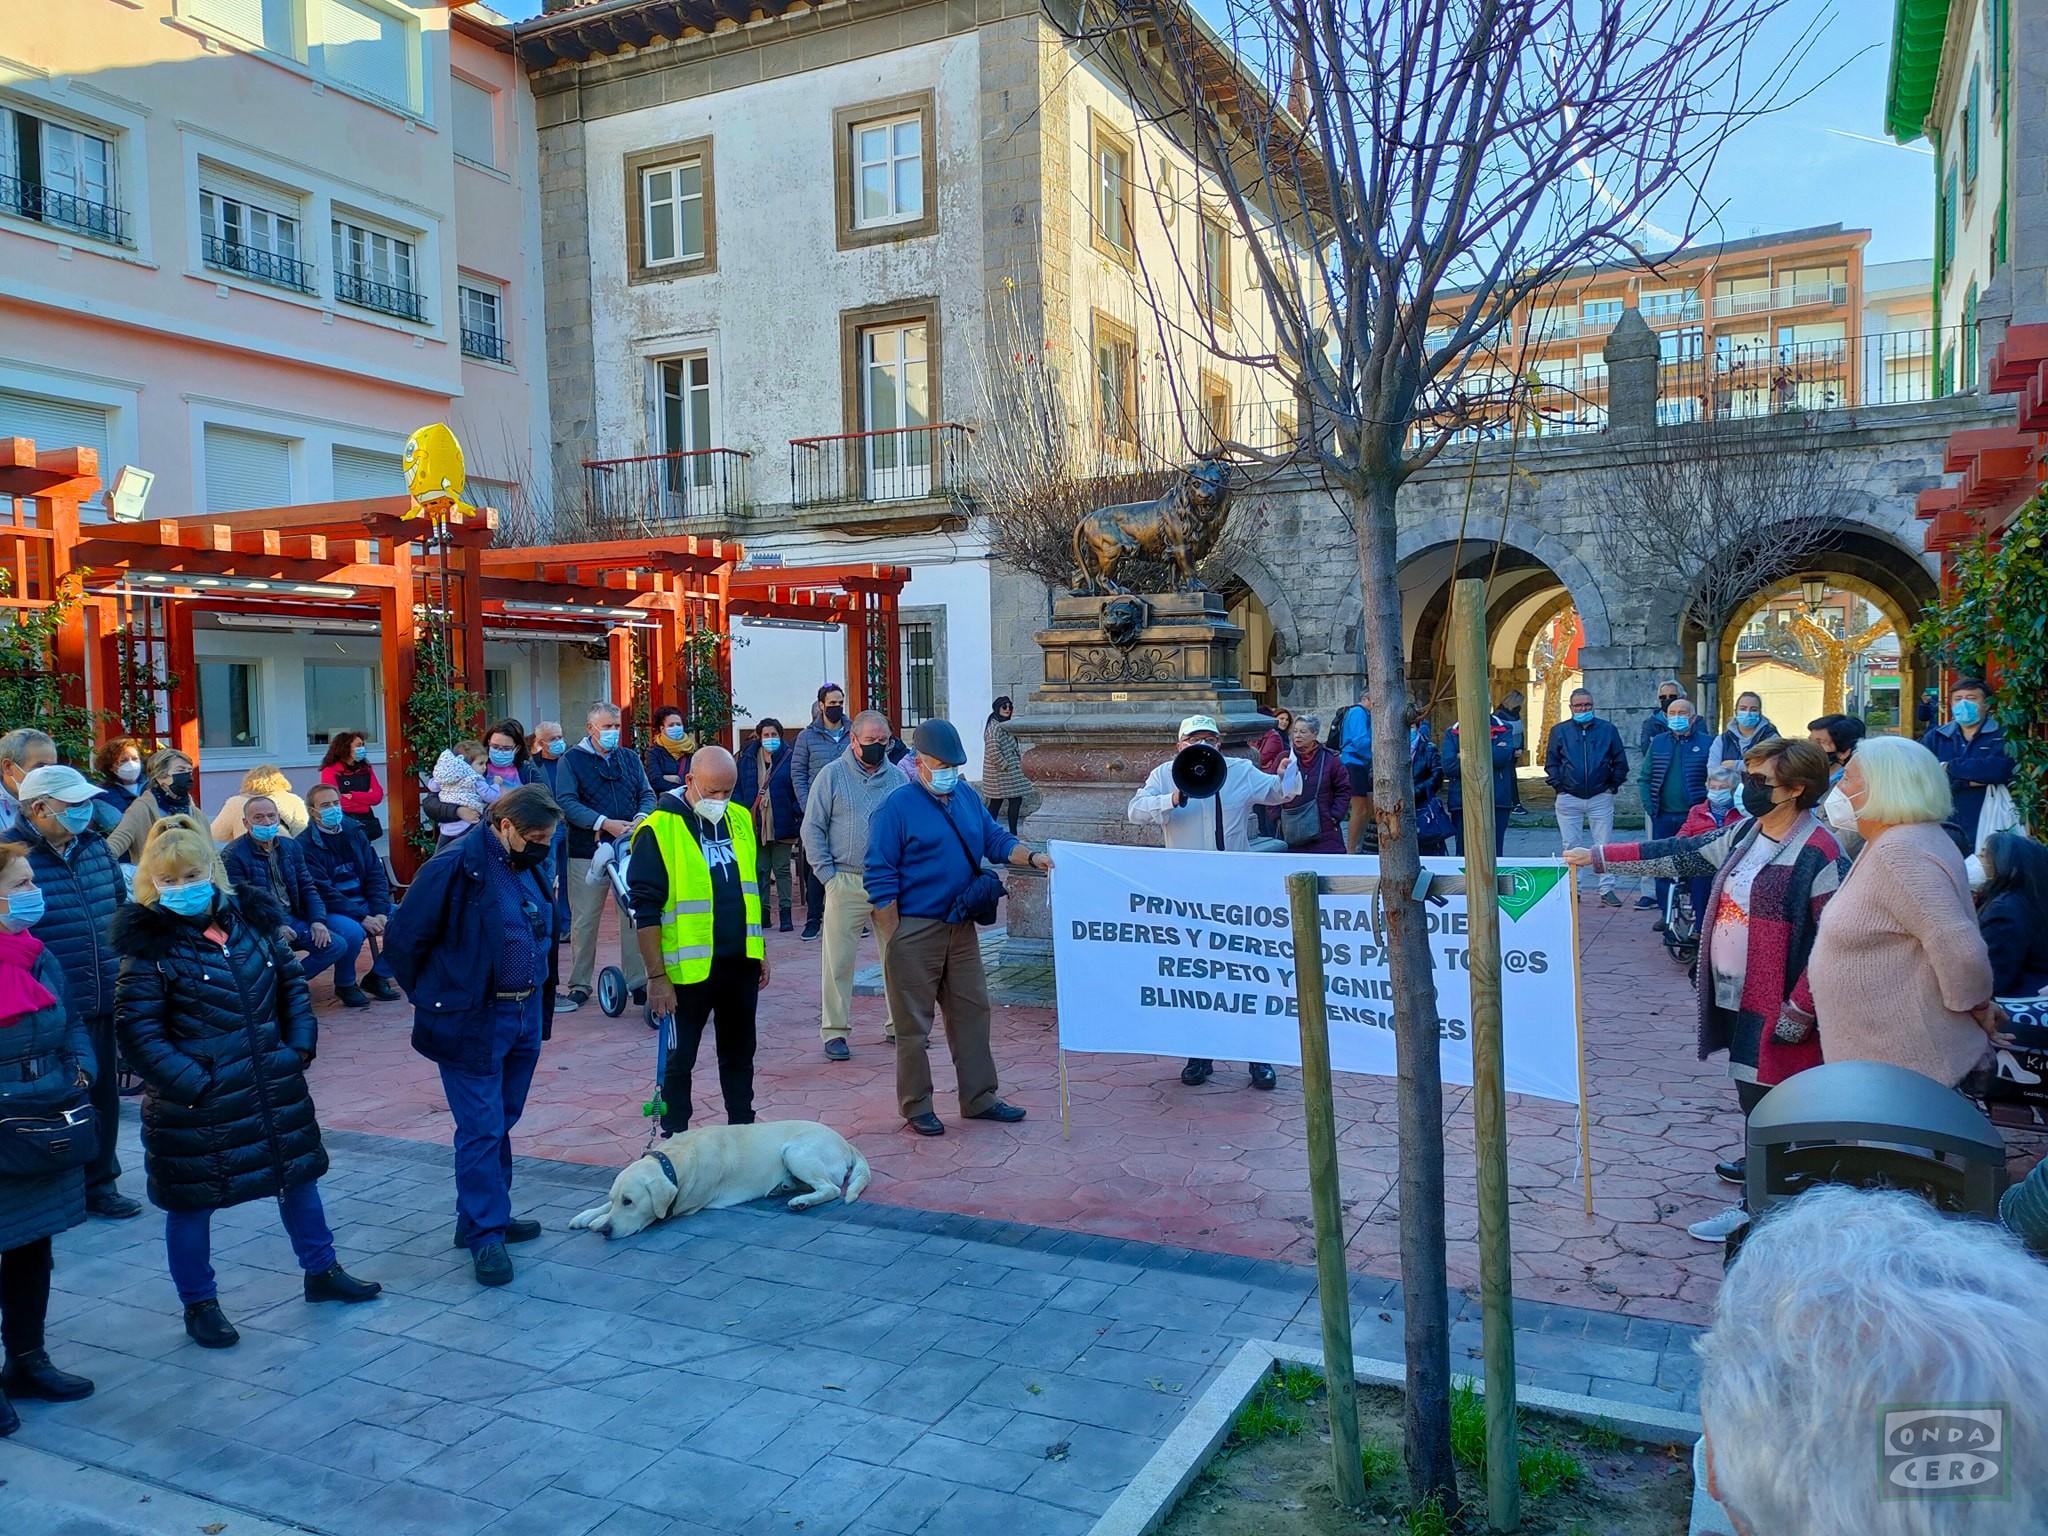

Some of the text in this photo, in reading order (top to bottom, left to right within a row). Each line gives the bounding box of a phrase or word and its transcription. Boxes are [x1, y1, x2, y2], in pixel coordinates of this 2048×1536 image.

[1129, 893, 1469, 935] PRIVILEGIOS ARA DIE
[1071, 920, 1549, 974] DEBERES Y DERECOS PA TO@S
[1158, 956, 1438, 1001] RESPETO Y IGNID
[1140, 986, 1467, 1040] BLINDAJE DE ENSIES
